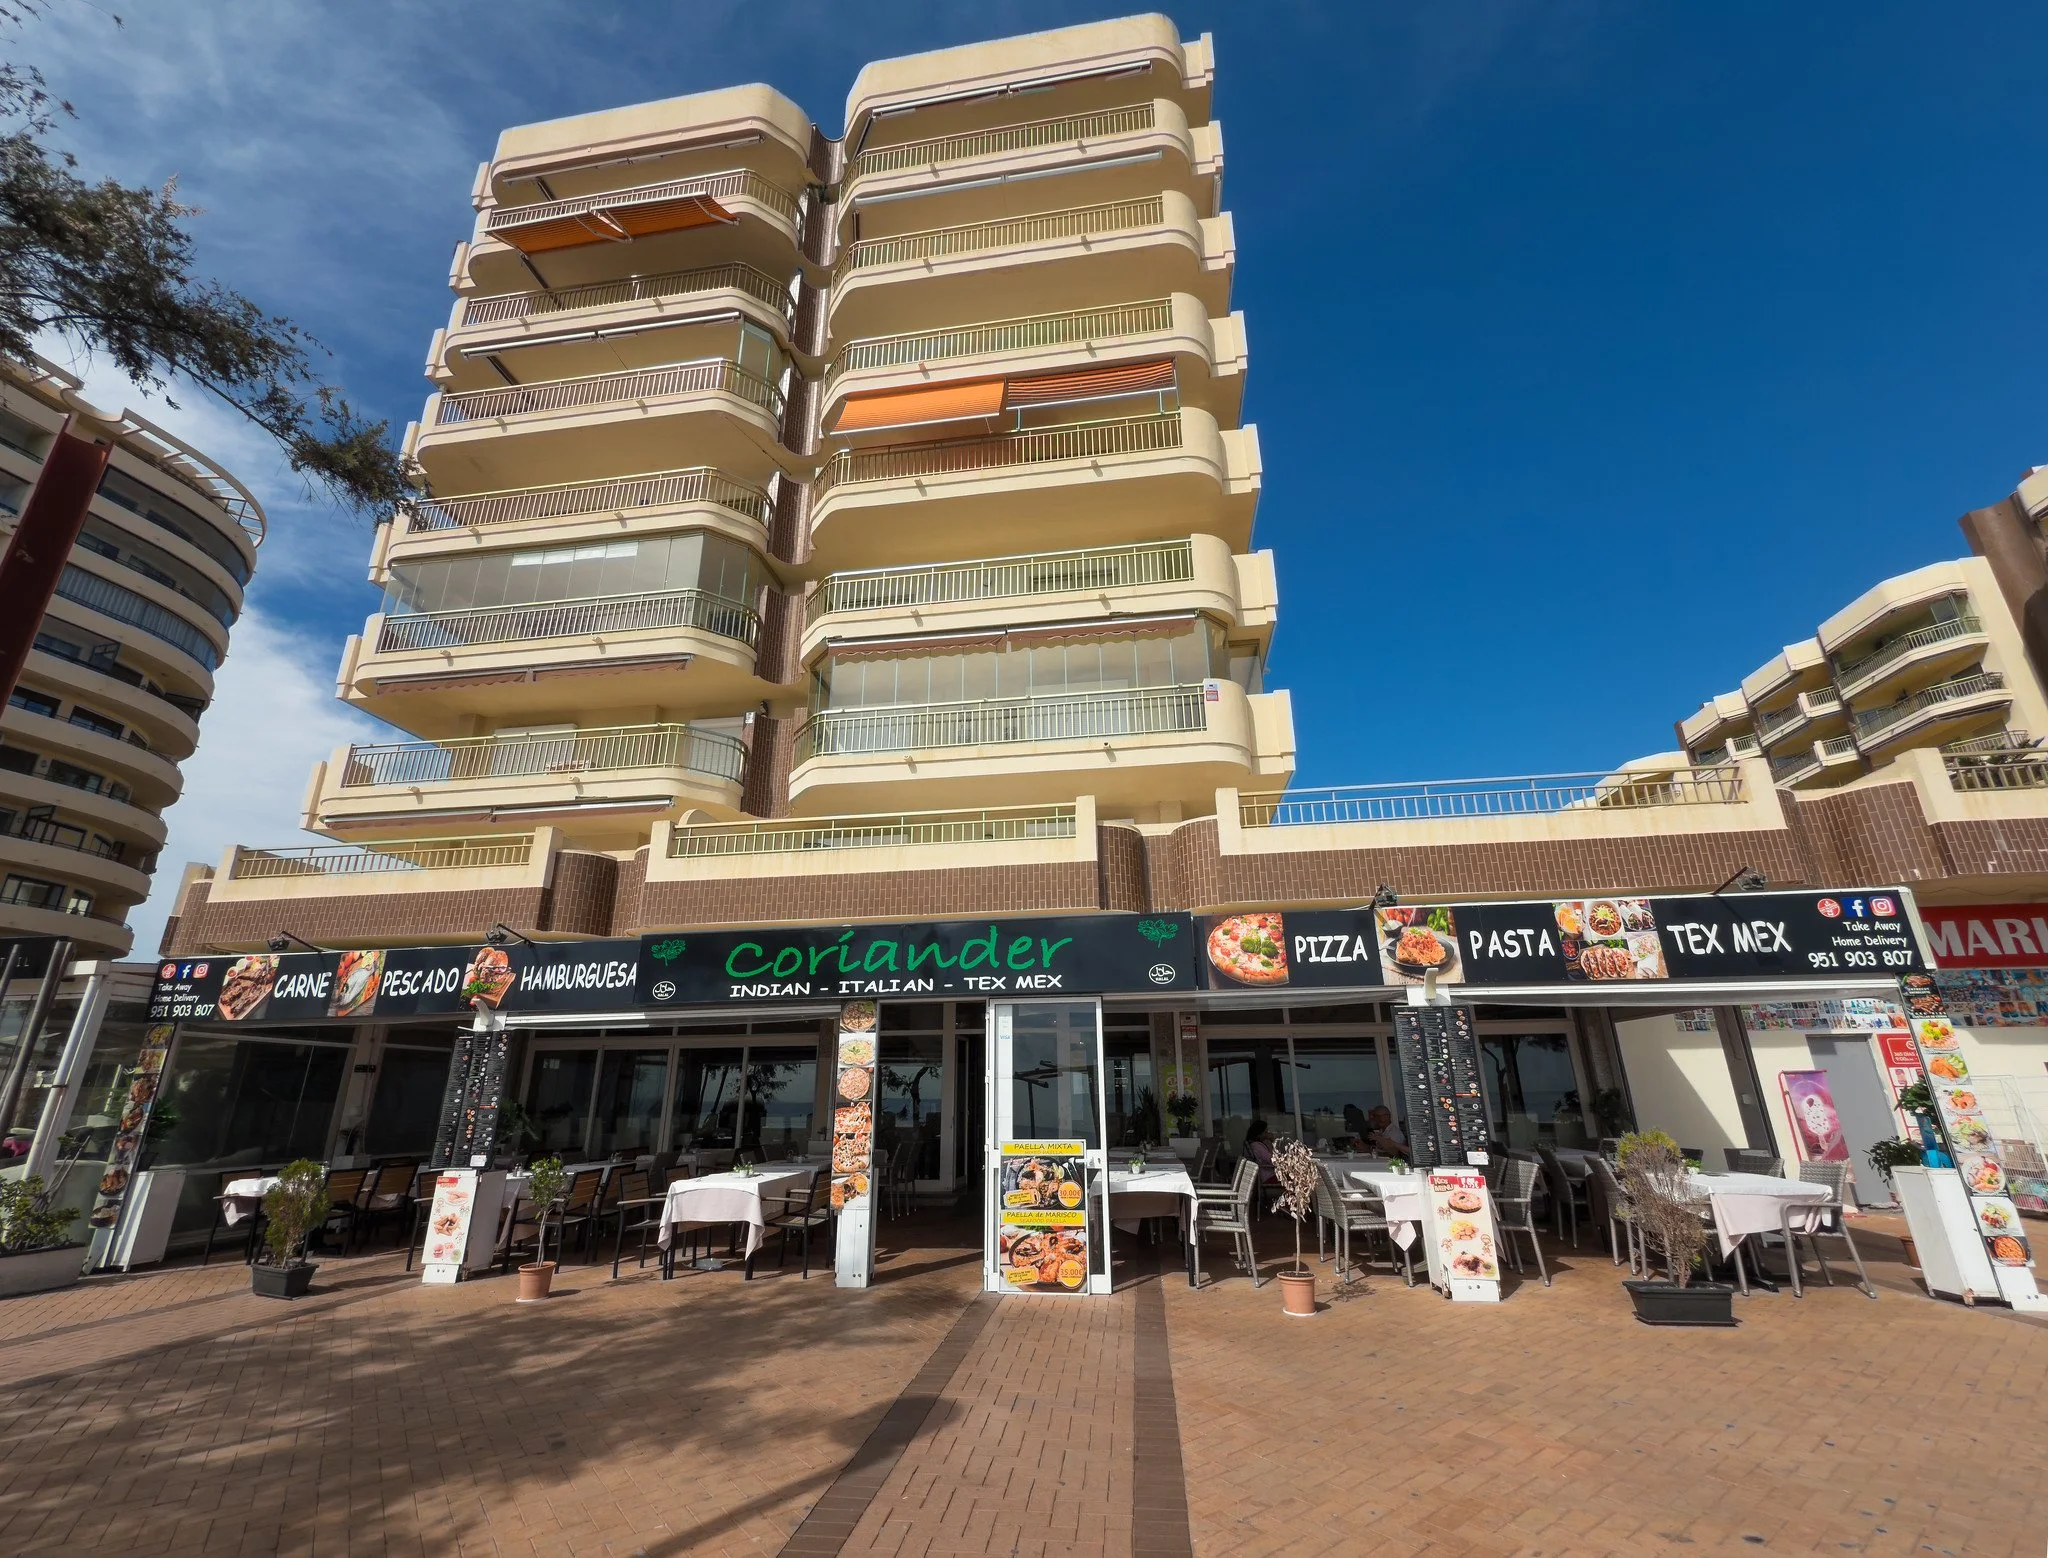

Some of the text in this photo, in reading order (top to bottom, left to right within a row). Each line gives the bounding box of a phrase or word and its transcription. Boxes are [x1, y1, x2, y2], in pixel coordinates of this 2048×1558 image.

[1666, 920, 1792, 955] TEX MEX
[1843, 921, 1900, 933] Take Away
[1294, 935, 1368, 963] PIZZA
[1470, 928, 1555, 960] PASTA
[1832, 935, 1907, 948] Home Delivery
[1808, 950, 1912, 968] 951 903 807
[274, 972, 332, 998] CARNE
[381, 968, 460, 996] PESCADO
[520, 961, 638, 991] HAMBURGUESA
[730, 982, 810, 997] INDIAN
[838, 978, 934, 994] ITALIAN
[964, 976, 1006, 990] TEX
[1016, 974, 1062, 989] MEX
[154, 994, 200, 1003] Home Delivery
[175, 984, 192, 992] Away
[150, 1004, 215, 1018] 951 903 807
